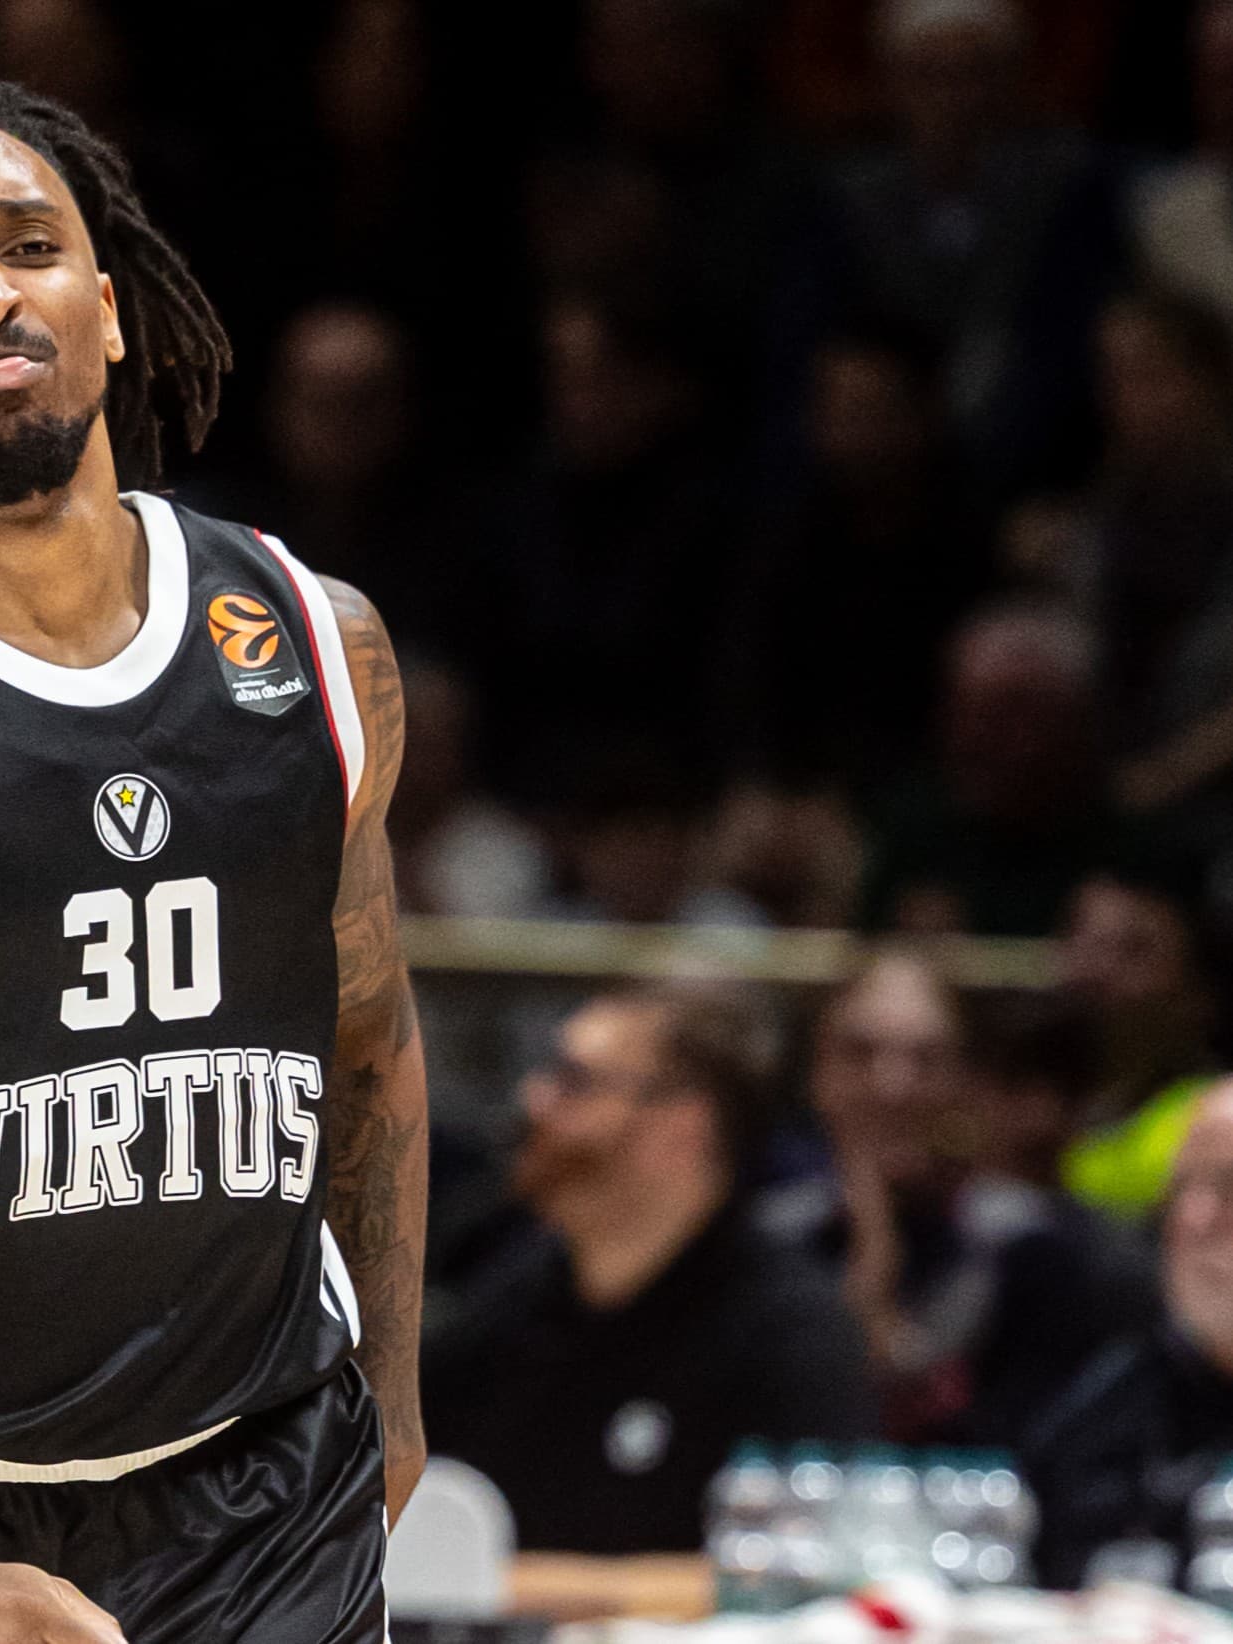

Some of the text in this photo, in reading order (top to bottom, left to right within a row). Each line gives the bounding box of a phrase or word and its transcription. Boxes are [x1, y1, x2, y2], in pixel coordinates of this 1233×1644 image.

[236, 687, 262, 702] abu
[262, 677, 304, 699] dhabi
[60, 876, 221, 1031] 30
